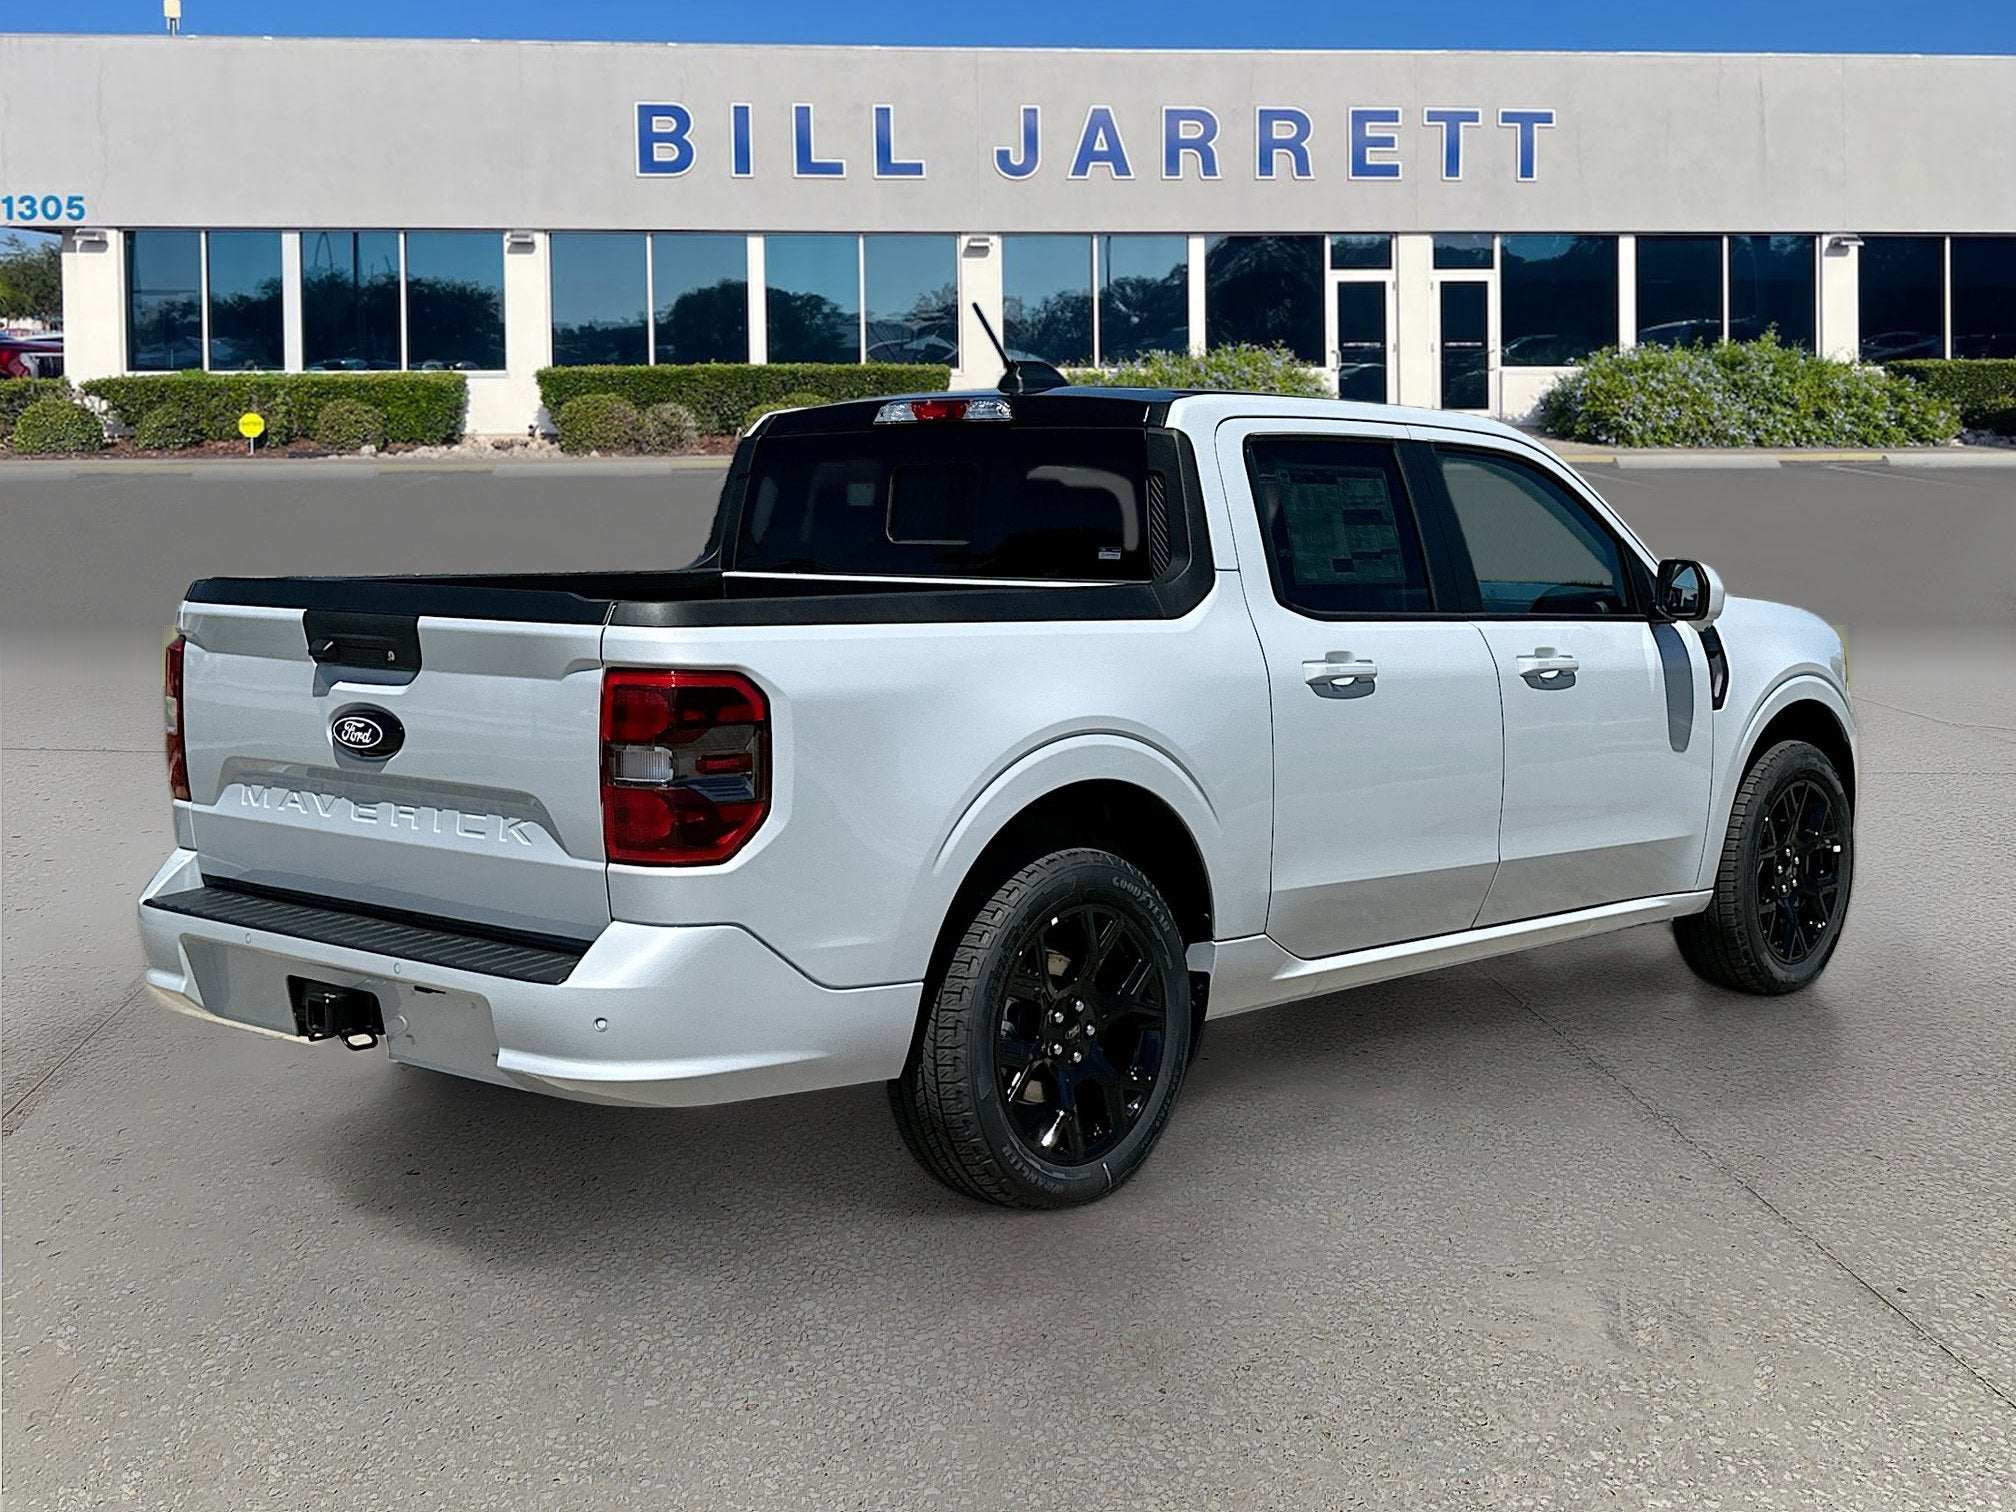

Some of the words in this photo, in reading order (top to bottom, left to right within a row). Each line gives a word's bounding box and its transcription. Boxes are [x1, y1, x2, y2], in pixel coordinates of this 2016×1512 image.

[634, 102, 926, 180] BILL
[993, 103, 1556, 183] JARRETT
[0, 194, 86, 221] 1305
[341, 720, 373, 744] Ford
[240, 783, 532, 847] MAVERICK
